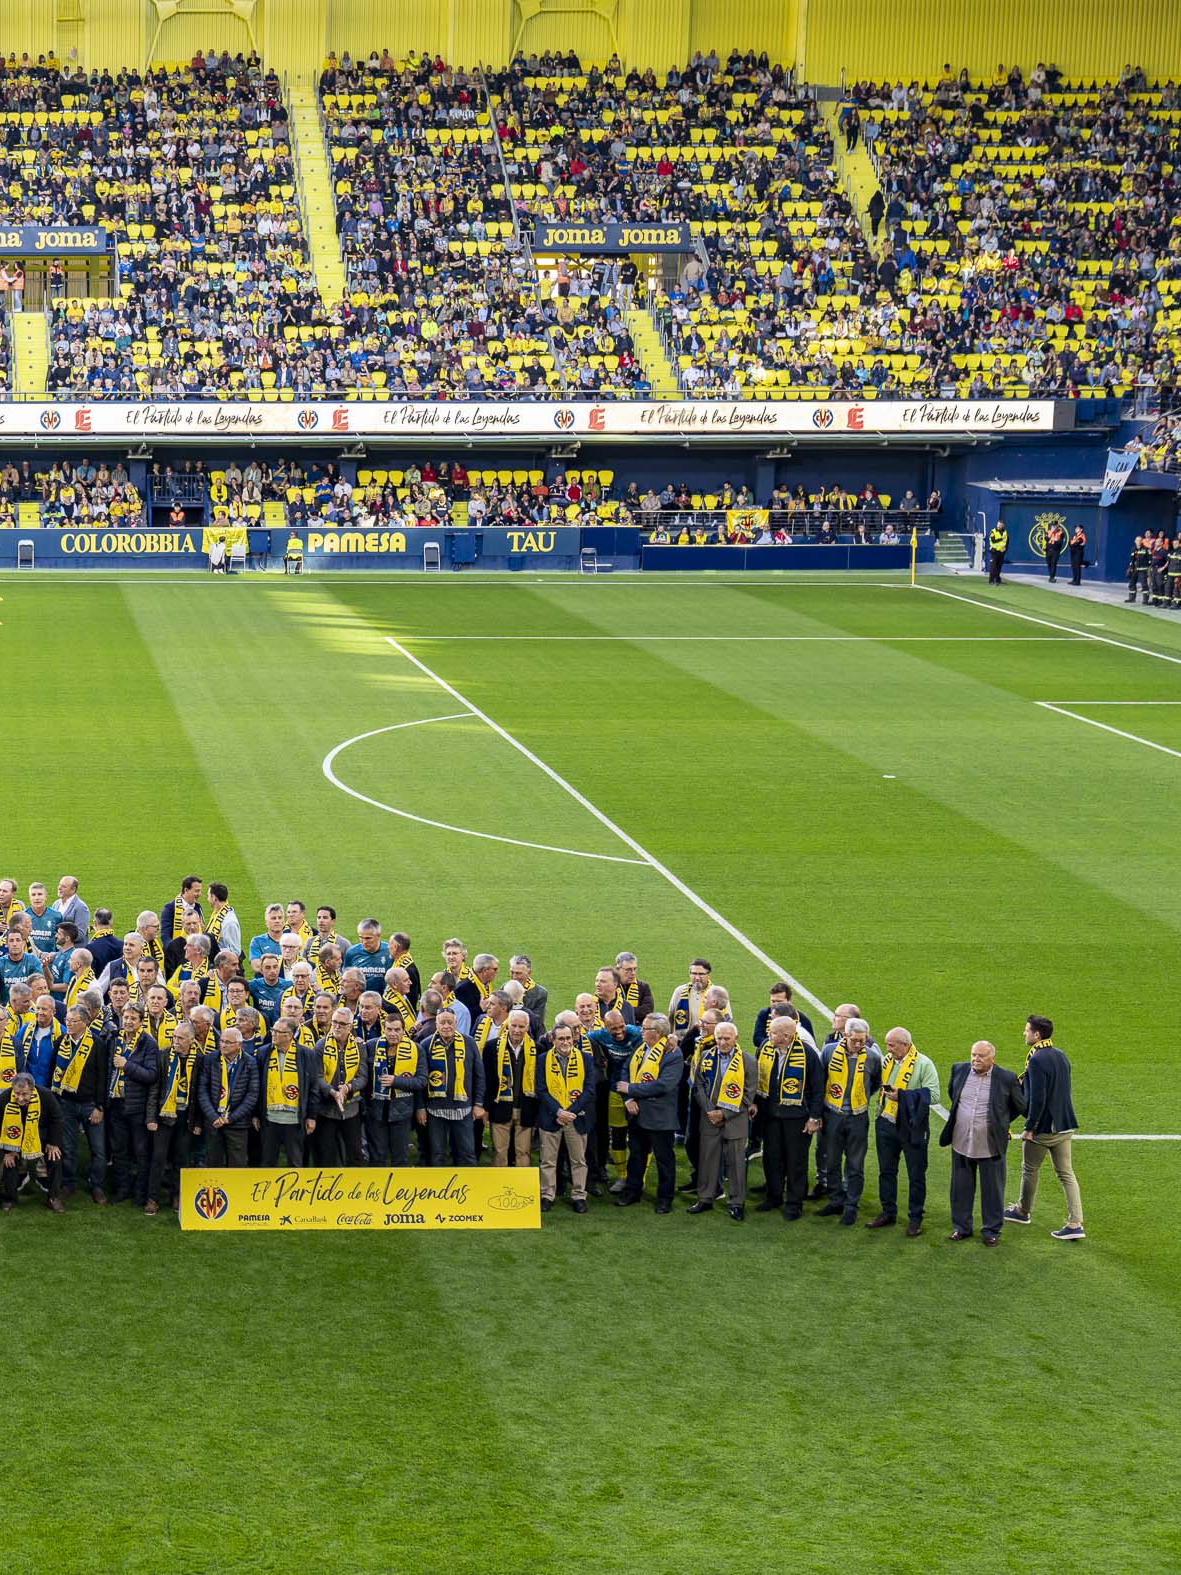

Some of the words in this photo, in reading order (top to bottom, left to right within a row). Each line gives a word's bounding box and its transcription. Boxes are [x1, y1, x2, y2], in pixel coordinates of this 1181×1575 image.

[125, 411, 139, 424] El
[141, 406, 182, 428] Partido
[196, 411, 212, 425] las
[213, 407, 263, 432] Leyendas
[383, 411, 397, 424] El
[399, 406, 440, 428] Partido
[454, 411, 470, 425] las
[471, 407, 521, 432] Leyendas
[641, 410, 655, 424] El
[656, 405, 697, 426] Partido
[711, 410, 727, 424] las
[728, 406, 778, 430] Leyendas
[903, 408, 917, 422] El
[919, 403, 960, 424] Partido
[974, 408, 990, 422] las
[991, 404, 1041, 428] Leyendas
[60, 534, 197, 554] COLOROBBIA
[307, 532, 406, 554] PAMESA
[506, 532, 557, 553] TAU
[251, 1180, 271, 1203] El
[274, 1170, 344, 1208] Partido
[347, 1182, 361, 1201] de
[365, 1181, 381, 1202] las
[382, 1172, 470, 1213] Leyendas
[238, 1214, 270, 1222] PAMESA
[294, 1216, 328, 1224] CaixaBank
[449, 1214, 484, 1222] ZOOMEX
